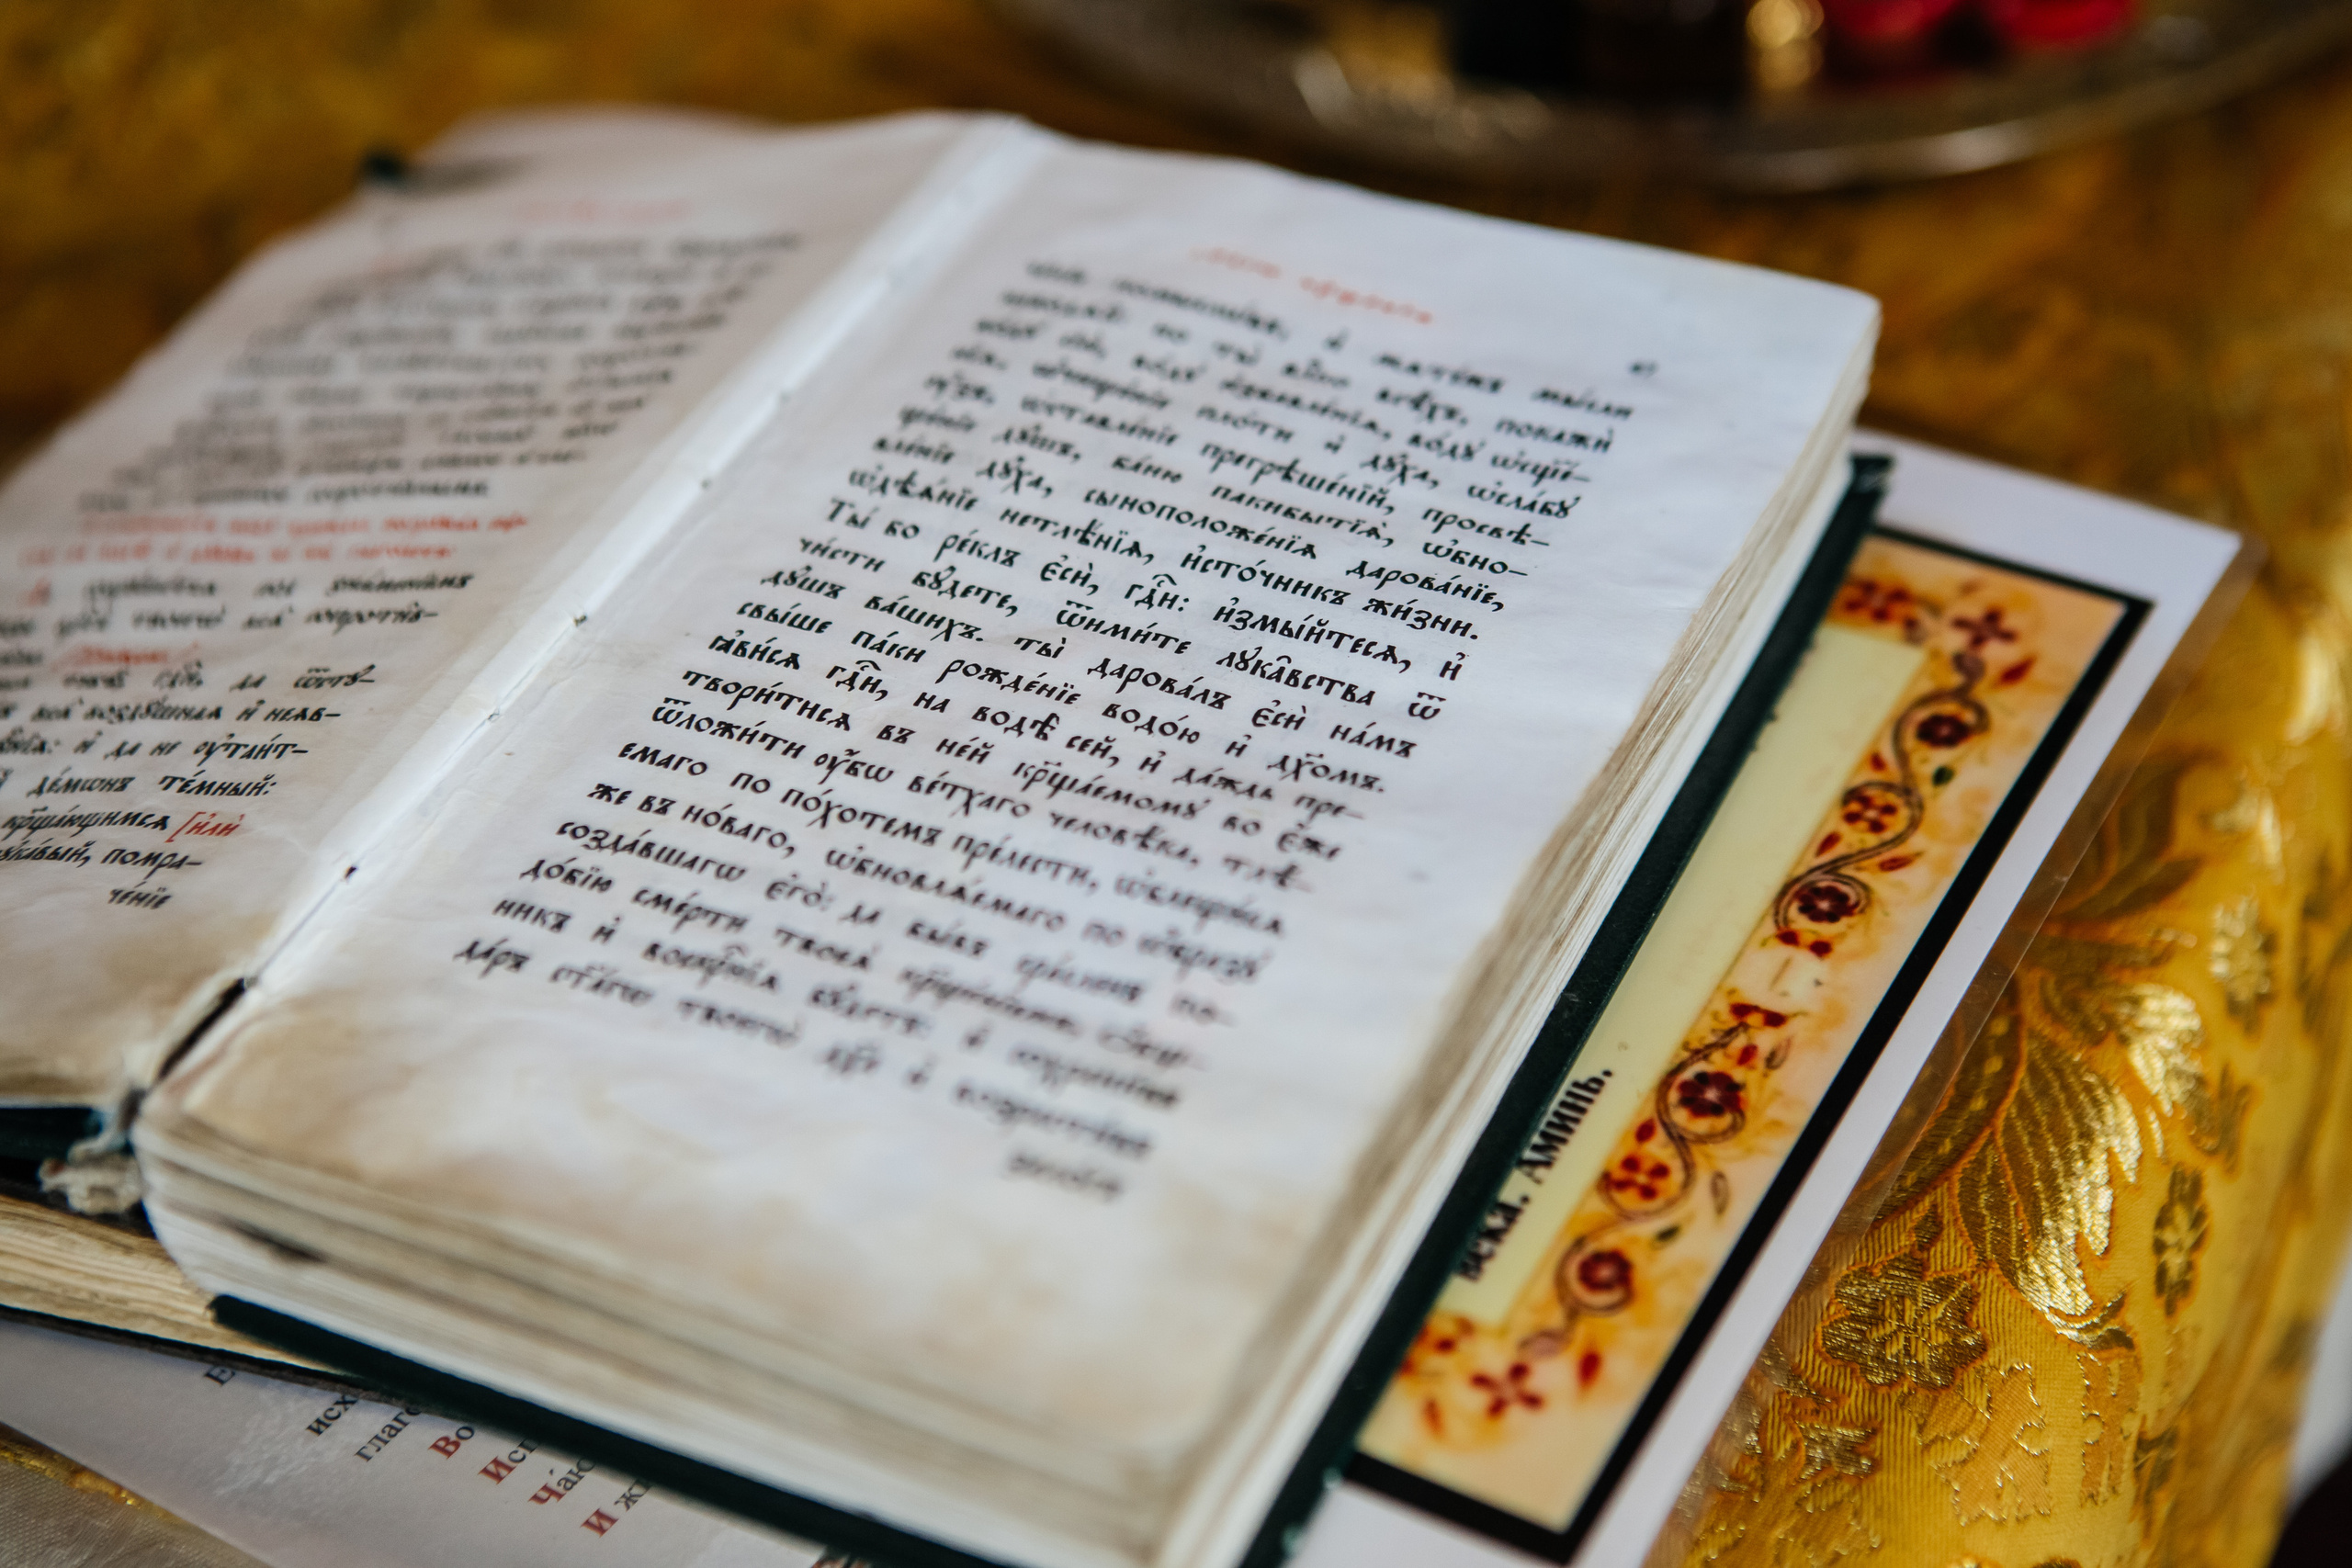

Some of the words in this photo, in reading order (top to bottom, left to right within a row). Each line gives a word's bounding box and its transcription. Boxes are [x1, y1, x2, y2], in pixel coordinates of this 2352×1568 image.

[913, 692, 951, 713] на
[876, 724, 916, 745] въ
[729, 772, 772, 795] по
[587, 783, 633, 806] же
[637, 795, 677, 816] въ
[580, 1507, 620, 1539] И
